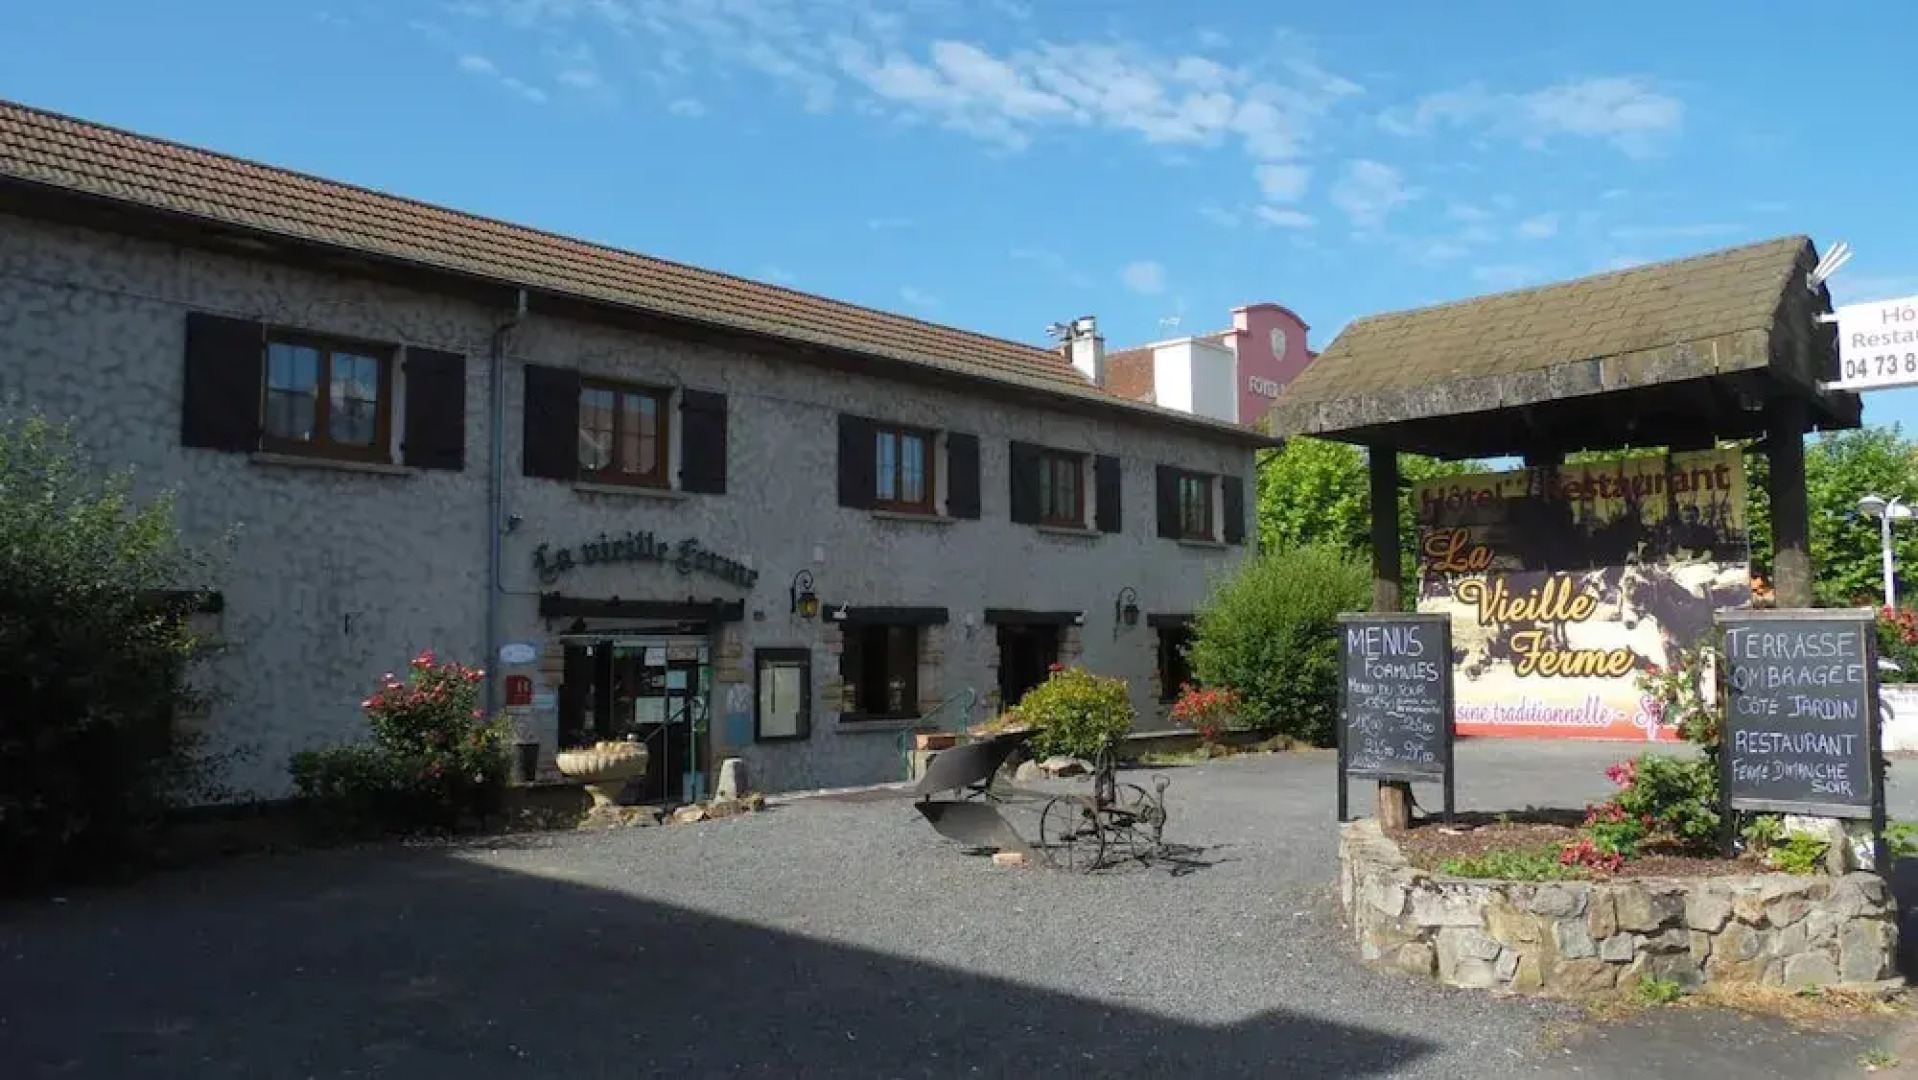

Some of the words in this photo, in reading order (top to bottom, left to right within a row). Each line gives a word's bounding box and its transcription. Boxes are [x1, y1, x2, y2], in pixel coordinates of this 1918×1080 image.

[1852, 330, 1918, 348] Resta
[1846, 358, 1868, 378] 04
[1875, 354, 1897, 375] 73
[1423, 528, 1495, 572] La
[1456, 575, 1597, 625] Vieille
[1348, 627, 1424, 657] MENUS
[1511, 630, 1636, 677] Ferme
[1726, 627, 1856, 660] TERRASSE
[1364, 657, 1439, 682] FORMULES
[1457, 701, 1489, 722] sine
[1494, 695, 1613, 724] traditionnelle
[1787, 694, 1858, 720] JARDIN
[1735, 730, 1858, 755] RESTAURANT
[1812, 780, 1853, 796] SOIR
